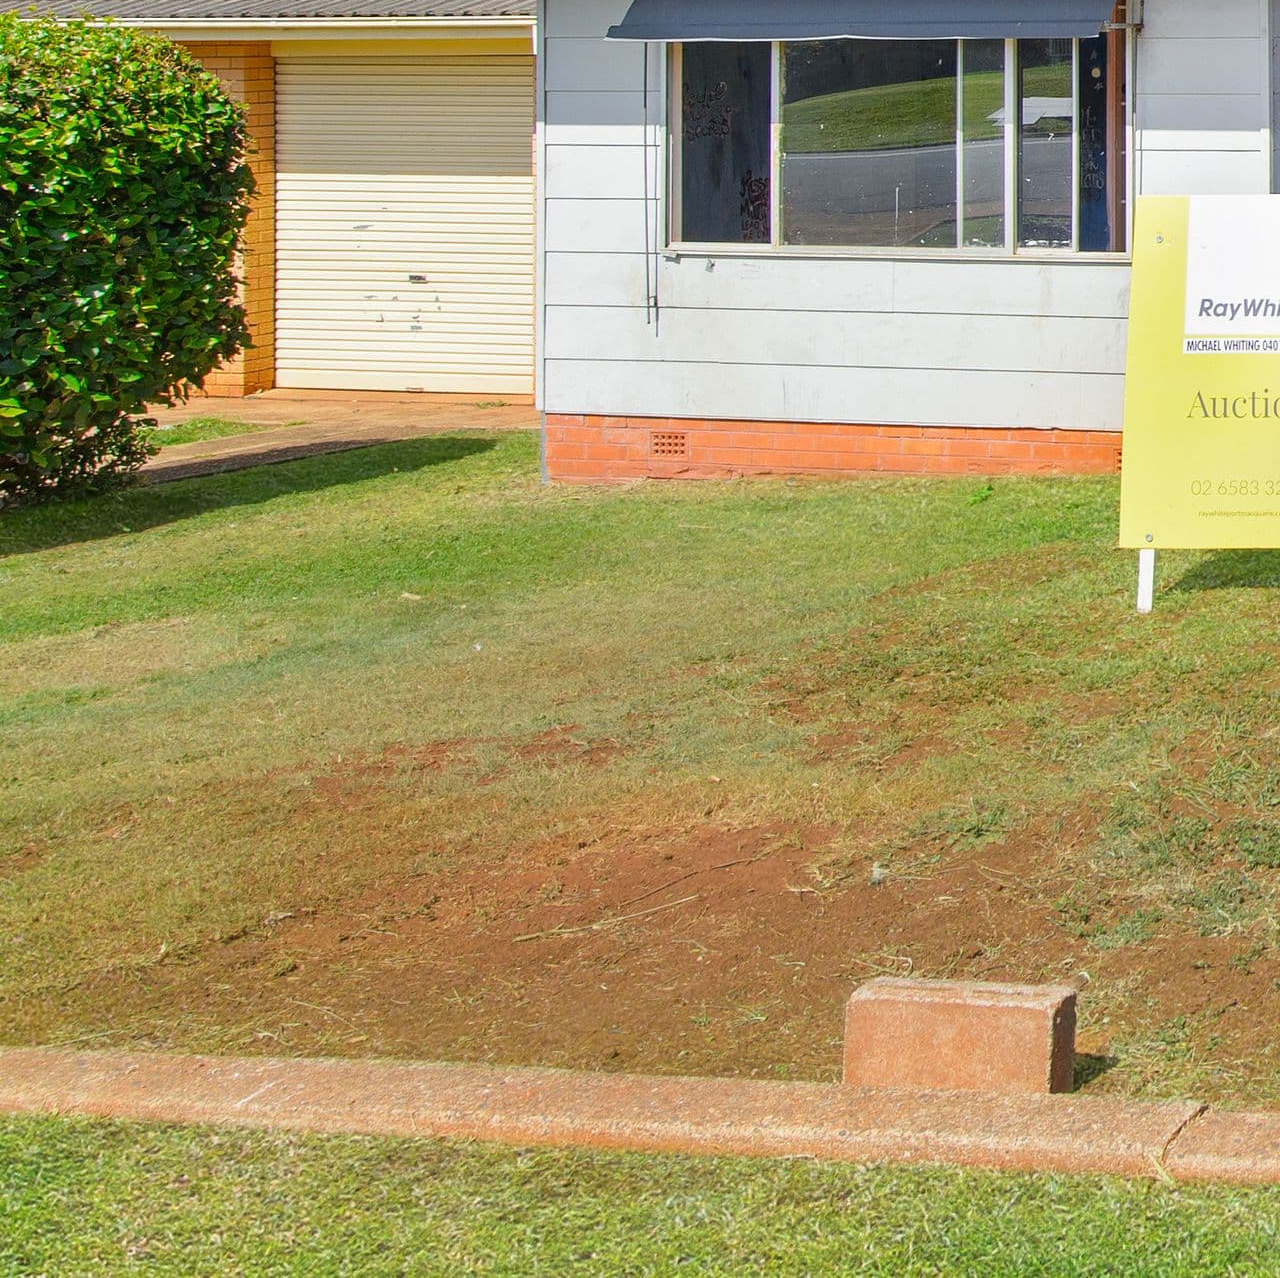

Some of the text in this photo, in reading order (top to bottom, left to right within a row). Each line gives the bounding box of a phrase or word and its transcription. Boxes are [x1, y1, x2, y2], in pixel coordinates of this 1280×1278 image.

[1186, 340, 1221, 351] MICHAEL
[1223, 340, 1260, 351] WHITING
[1191, 480, 1212, 496] 02
[1217, 480, 1259, 496] 6583
